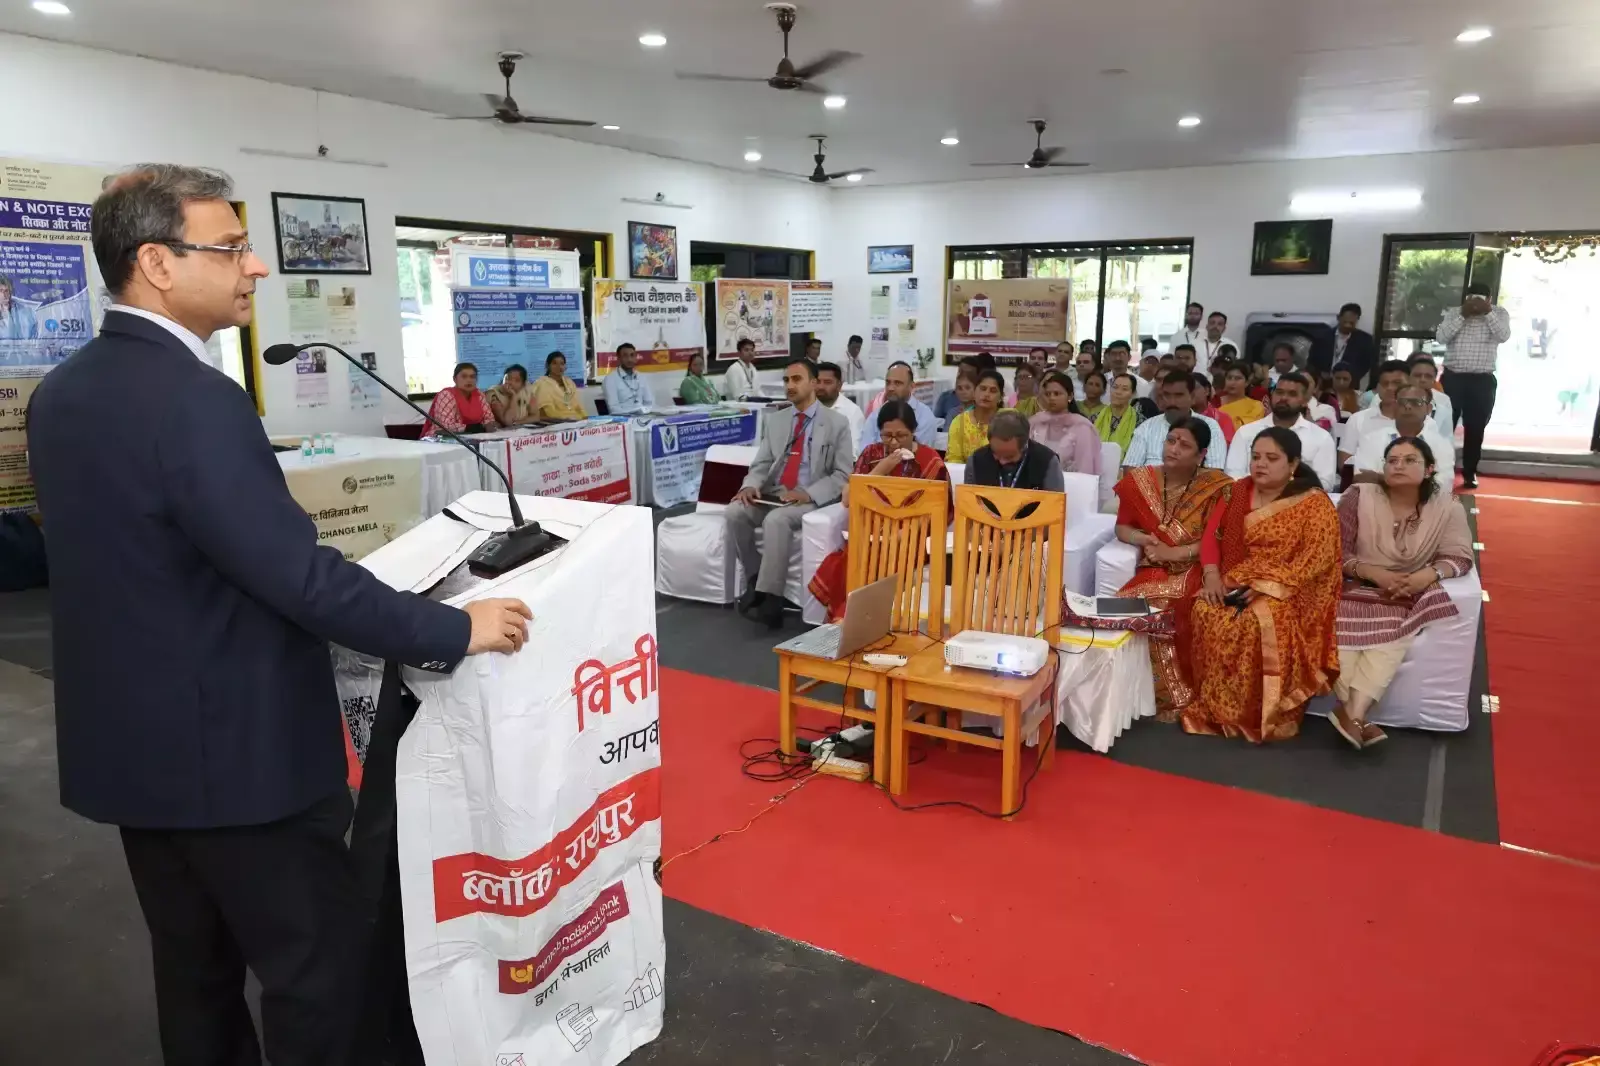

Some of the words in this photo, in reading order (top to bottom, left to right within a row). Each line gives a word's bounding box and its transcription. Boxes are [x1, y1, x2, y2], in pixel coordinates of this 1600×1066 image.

[14, 201, 23, 213] &
[27, 203, 65, 216] NOTE
[53, 217, 69, 230] और
[71, 219, 87, 231] नोट
[613, 287, 646, 302] पंजाब
[648, 286, 682, 303] नैशनल
[60, 318, 86, 332] SBI
[0, 387, 18, 399] SBI
[534, 485, 564, 498] Branch
[568, 477, 590, 489] Soda
[590, 469, 612, 483] Saroli
[319, 508, 350, 521] विनिमय
[351, 505, 368, 516] मेला
[357, 522, 378, 533] MELA
[565, 792, 636, 870] रायपुर
[561, 910, 601, 945] national
[534, 978, 559, 1007] द्वारा
[560, 940, 611, 981] संचालित
